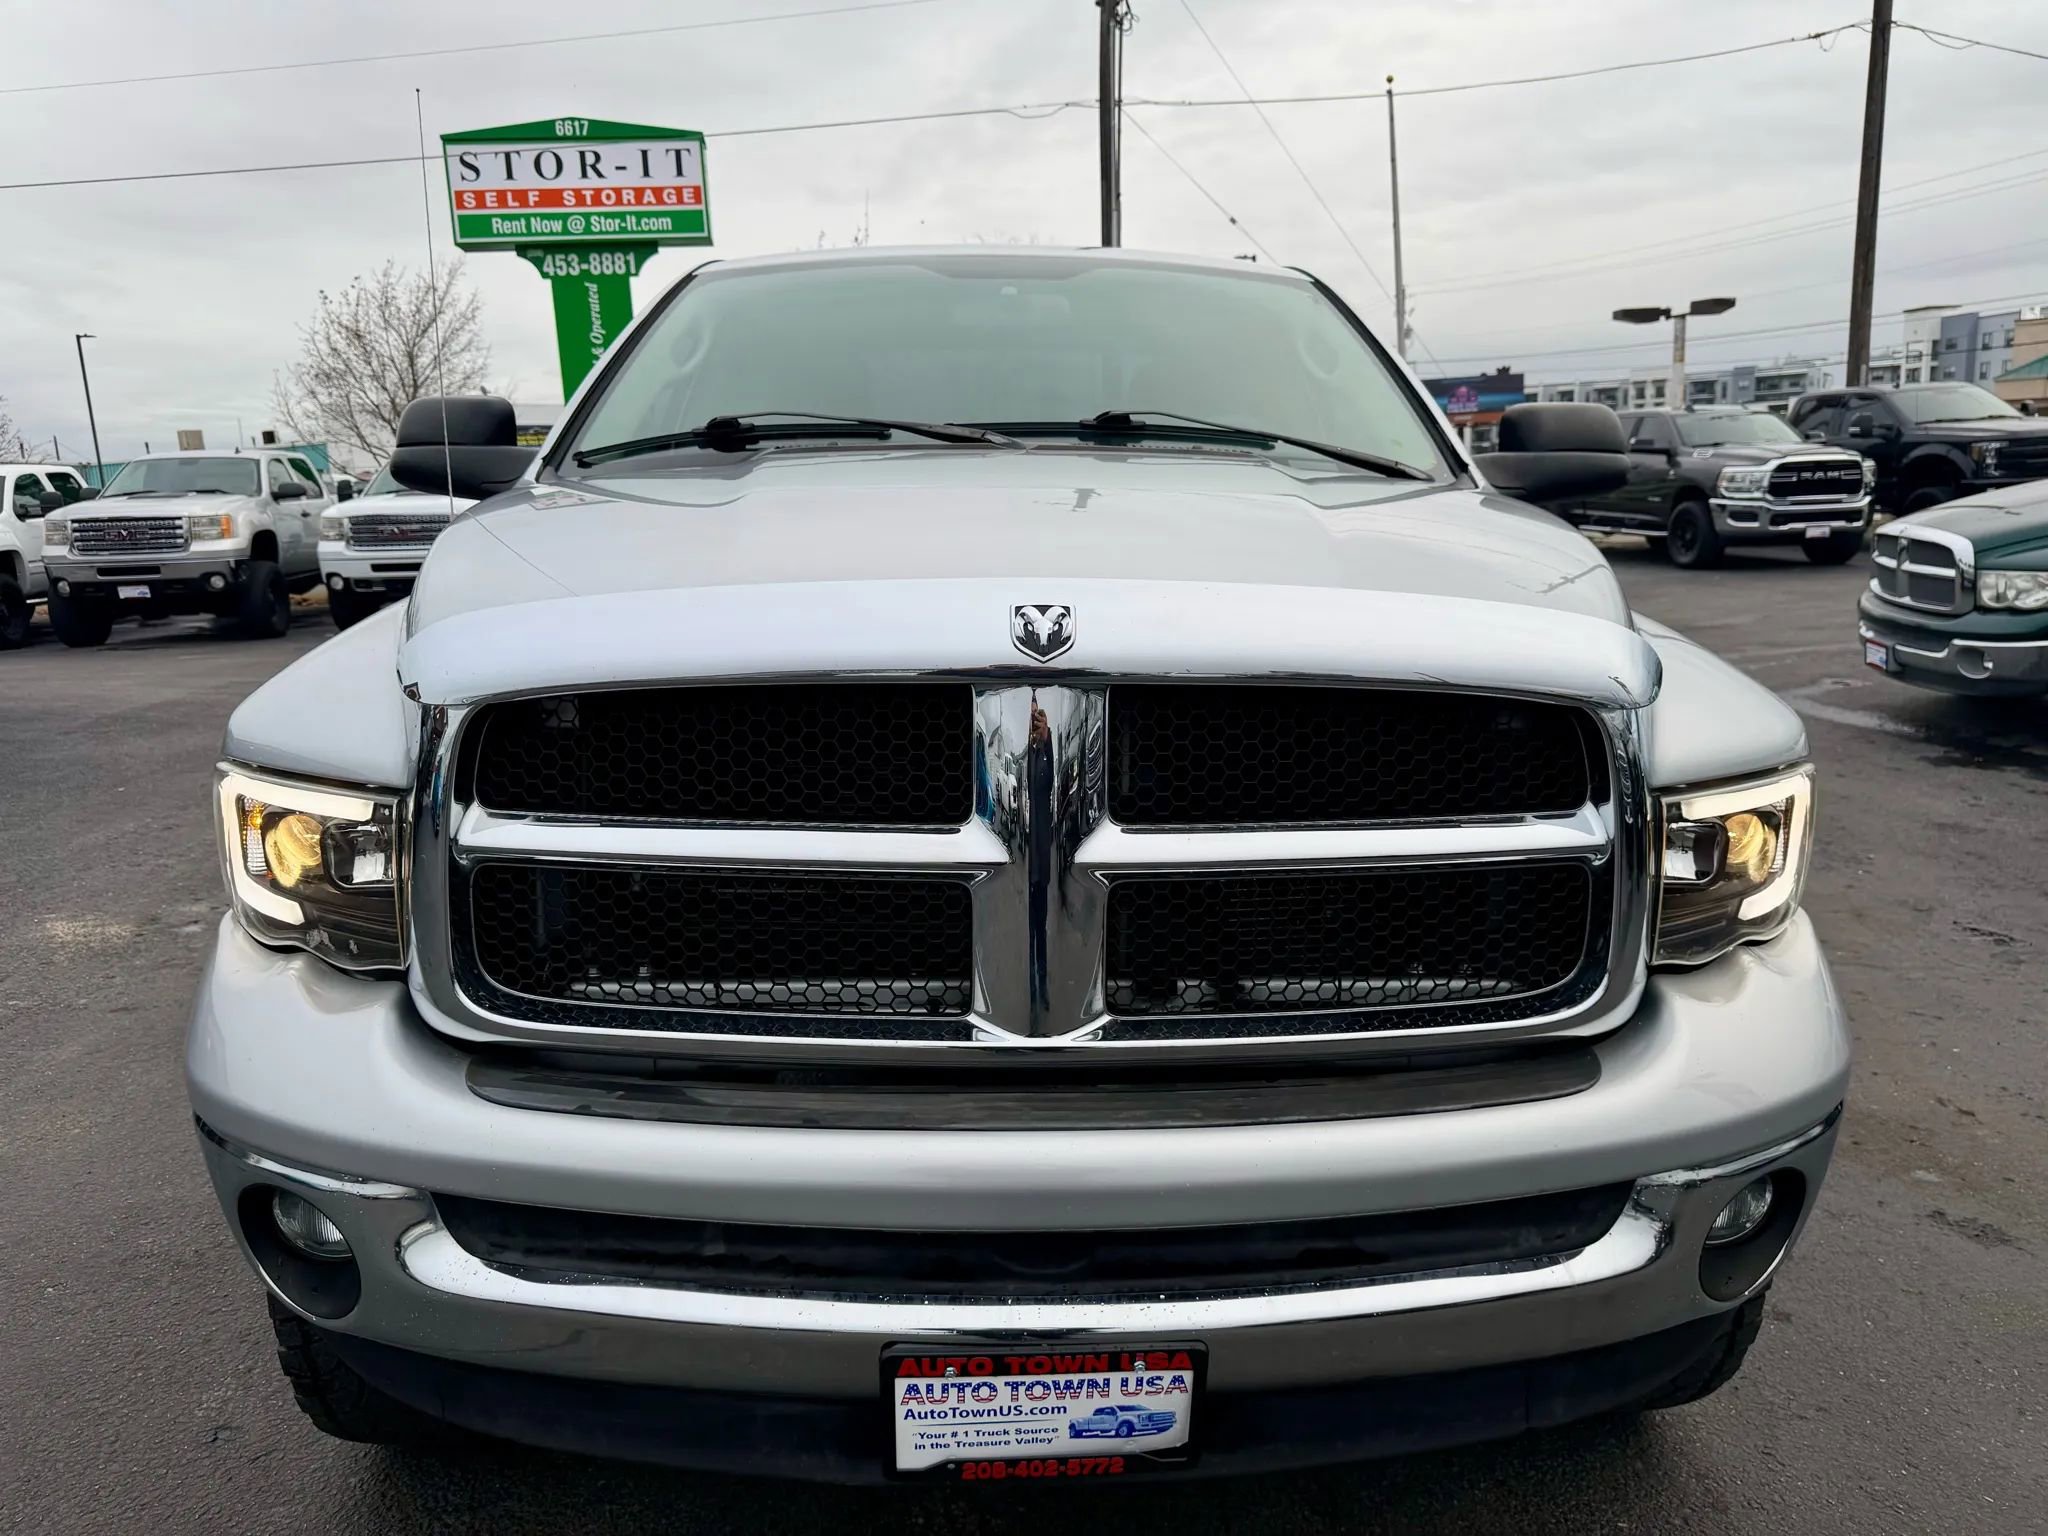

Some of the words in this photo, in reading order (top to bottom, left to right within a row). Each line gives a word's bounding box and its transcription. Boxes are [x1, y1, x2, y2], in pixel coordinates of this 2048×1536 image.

[555, 120, 589, 137] 6617
[458, 148, 692, 183] STOR-IT
[462, 190, 541, 209] SELF
[563, 188, 696, 206] STORAGE
[492, 216, 528, 234] Rent
[531, 216, 563, 233] Now
[567, 215, 585, 233] @
[591, 216, 673, 232] Stor-It.com
[543, 252, 639, 277] 453-8881
[584, 281, 606, 345] Operated
[1801, 470, 1840, 480] RAM
[897, 1356, 994, 1377] AUTO
[1004, 1353, 1109, 1375] TOWN
[1121, 1351, 1193, 1371] USA
[900, 1381, 998, 1406] AUTO
[1004, 1378, 1111, 1402] TOWN
[1120, 1374, 1189, 1397] USA
[903, 1404, 1067, 1420] AutoTownUS.com
[974, 1428, 1010, 1437] Truck
[1014, 1426, 1059, 1435] Source
[914, 1442, 926, 1450] in
[930, 1441, 951, 1449] the
[955, 1438, 1011, 1448] Treasure
[961, 1457, 1125, 1480] 208-402-5772
